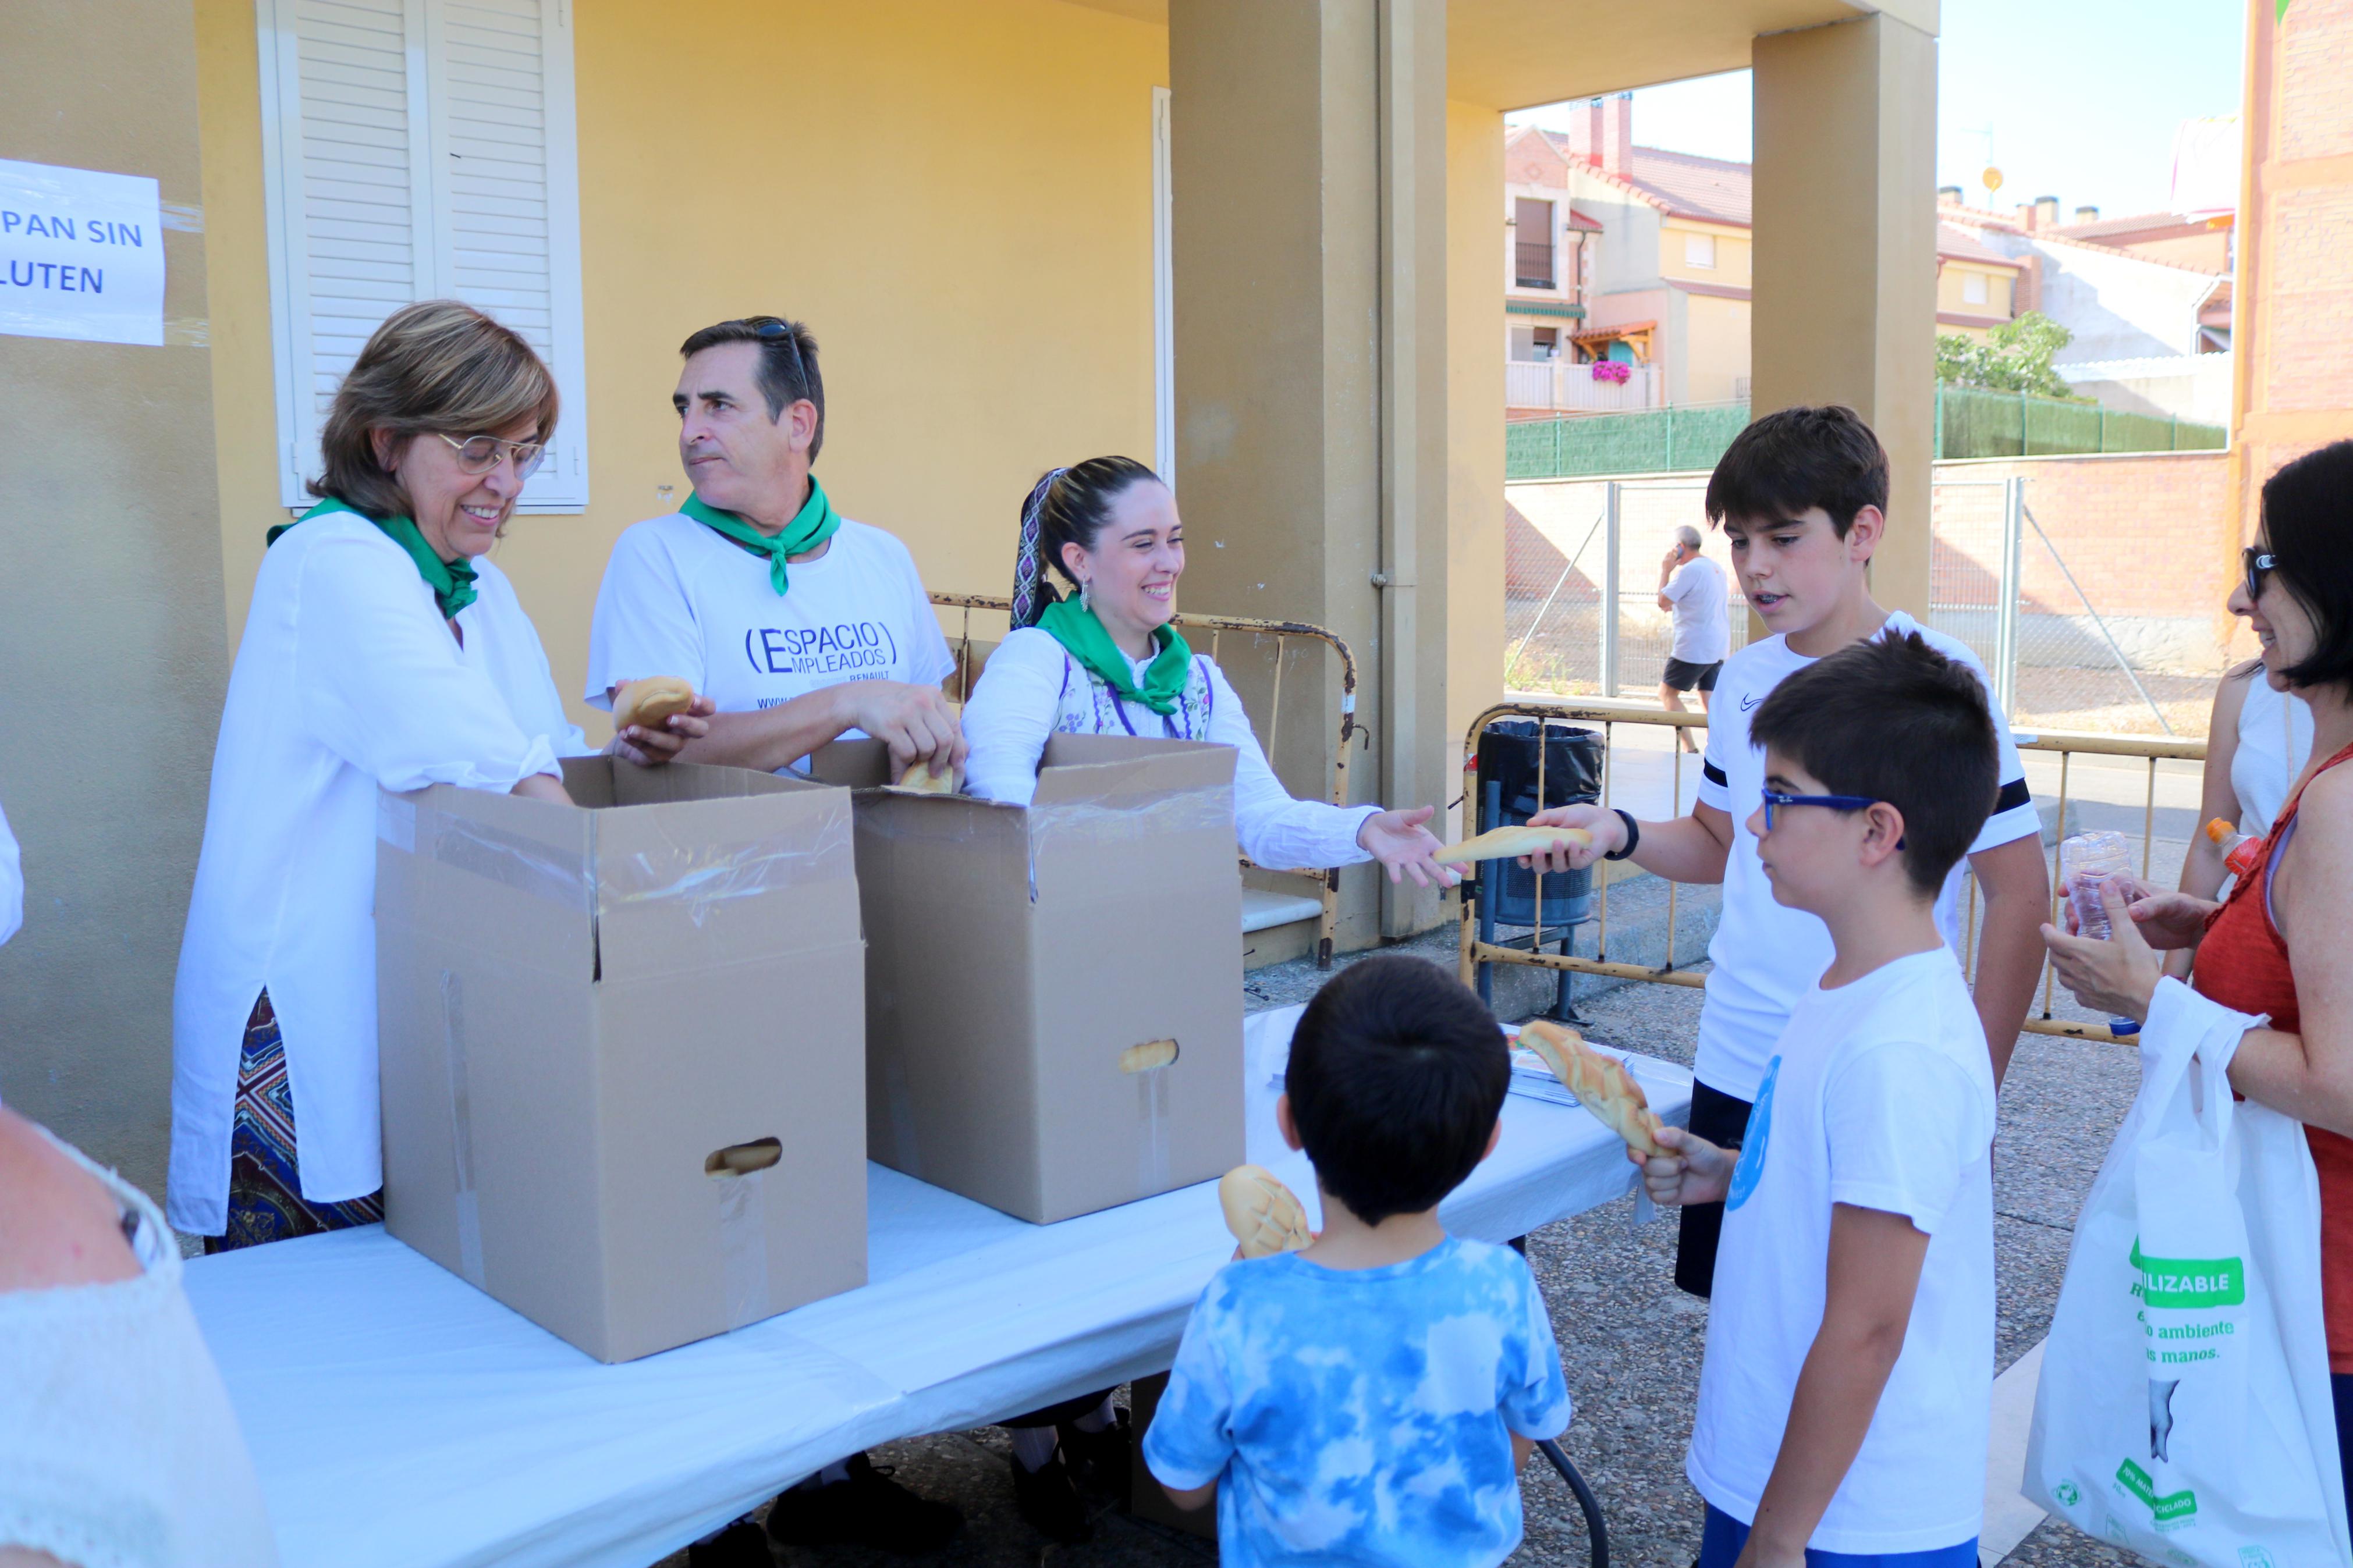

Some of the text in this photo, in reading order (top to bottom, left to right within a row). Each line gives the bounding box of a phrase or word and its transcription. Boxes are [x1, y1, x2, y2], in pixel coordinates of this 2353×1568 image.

[2, 211, 142, 247] PAN SIN
[2158, 1321, 2234, 1339] ambiente
[2161, 1348, 2220, 1363] manos.
